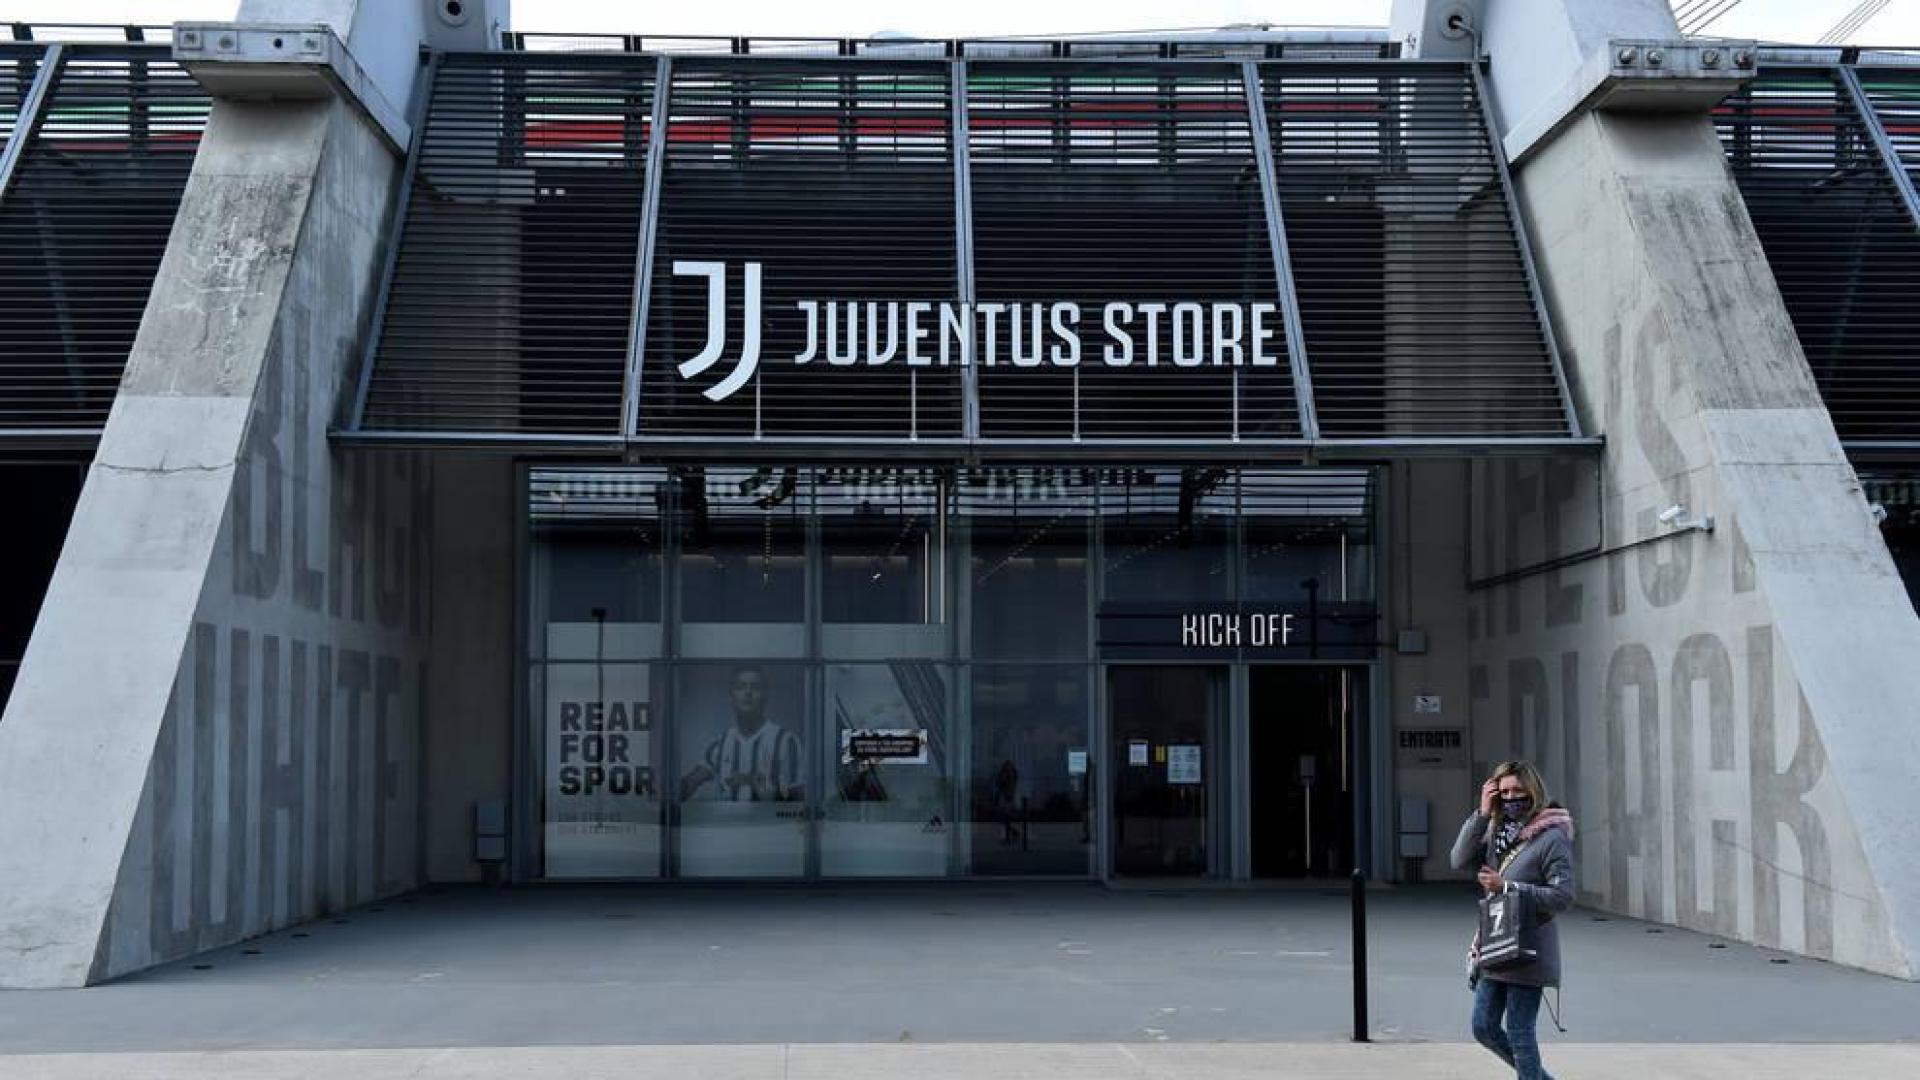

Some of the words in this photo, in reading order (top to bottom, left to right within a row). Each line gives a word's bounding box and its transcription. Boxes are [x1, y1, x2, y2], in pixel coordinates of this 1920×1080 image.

[795, 300, 1081, 366] JUVENTUS
[1102, 301, 1277, 366] STORE
[1182, 614, 1241, 647] KICK
[1250, 614, 1294, 647] OFF
[560, 734, 629, 763] FOR
[560, 766, 655, 796] SPOR
